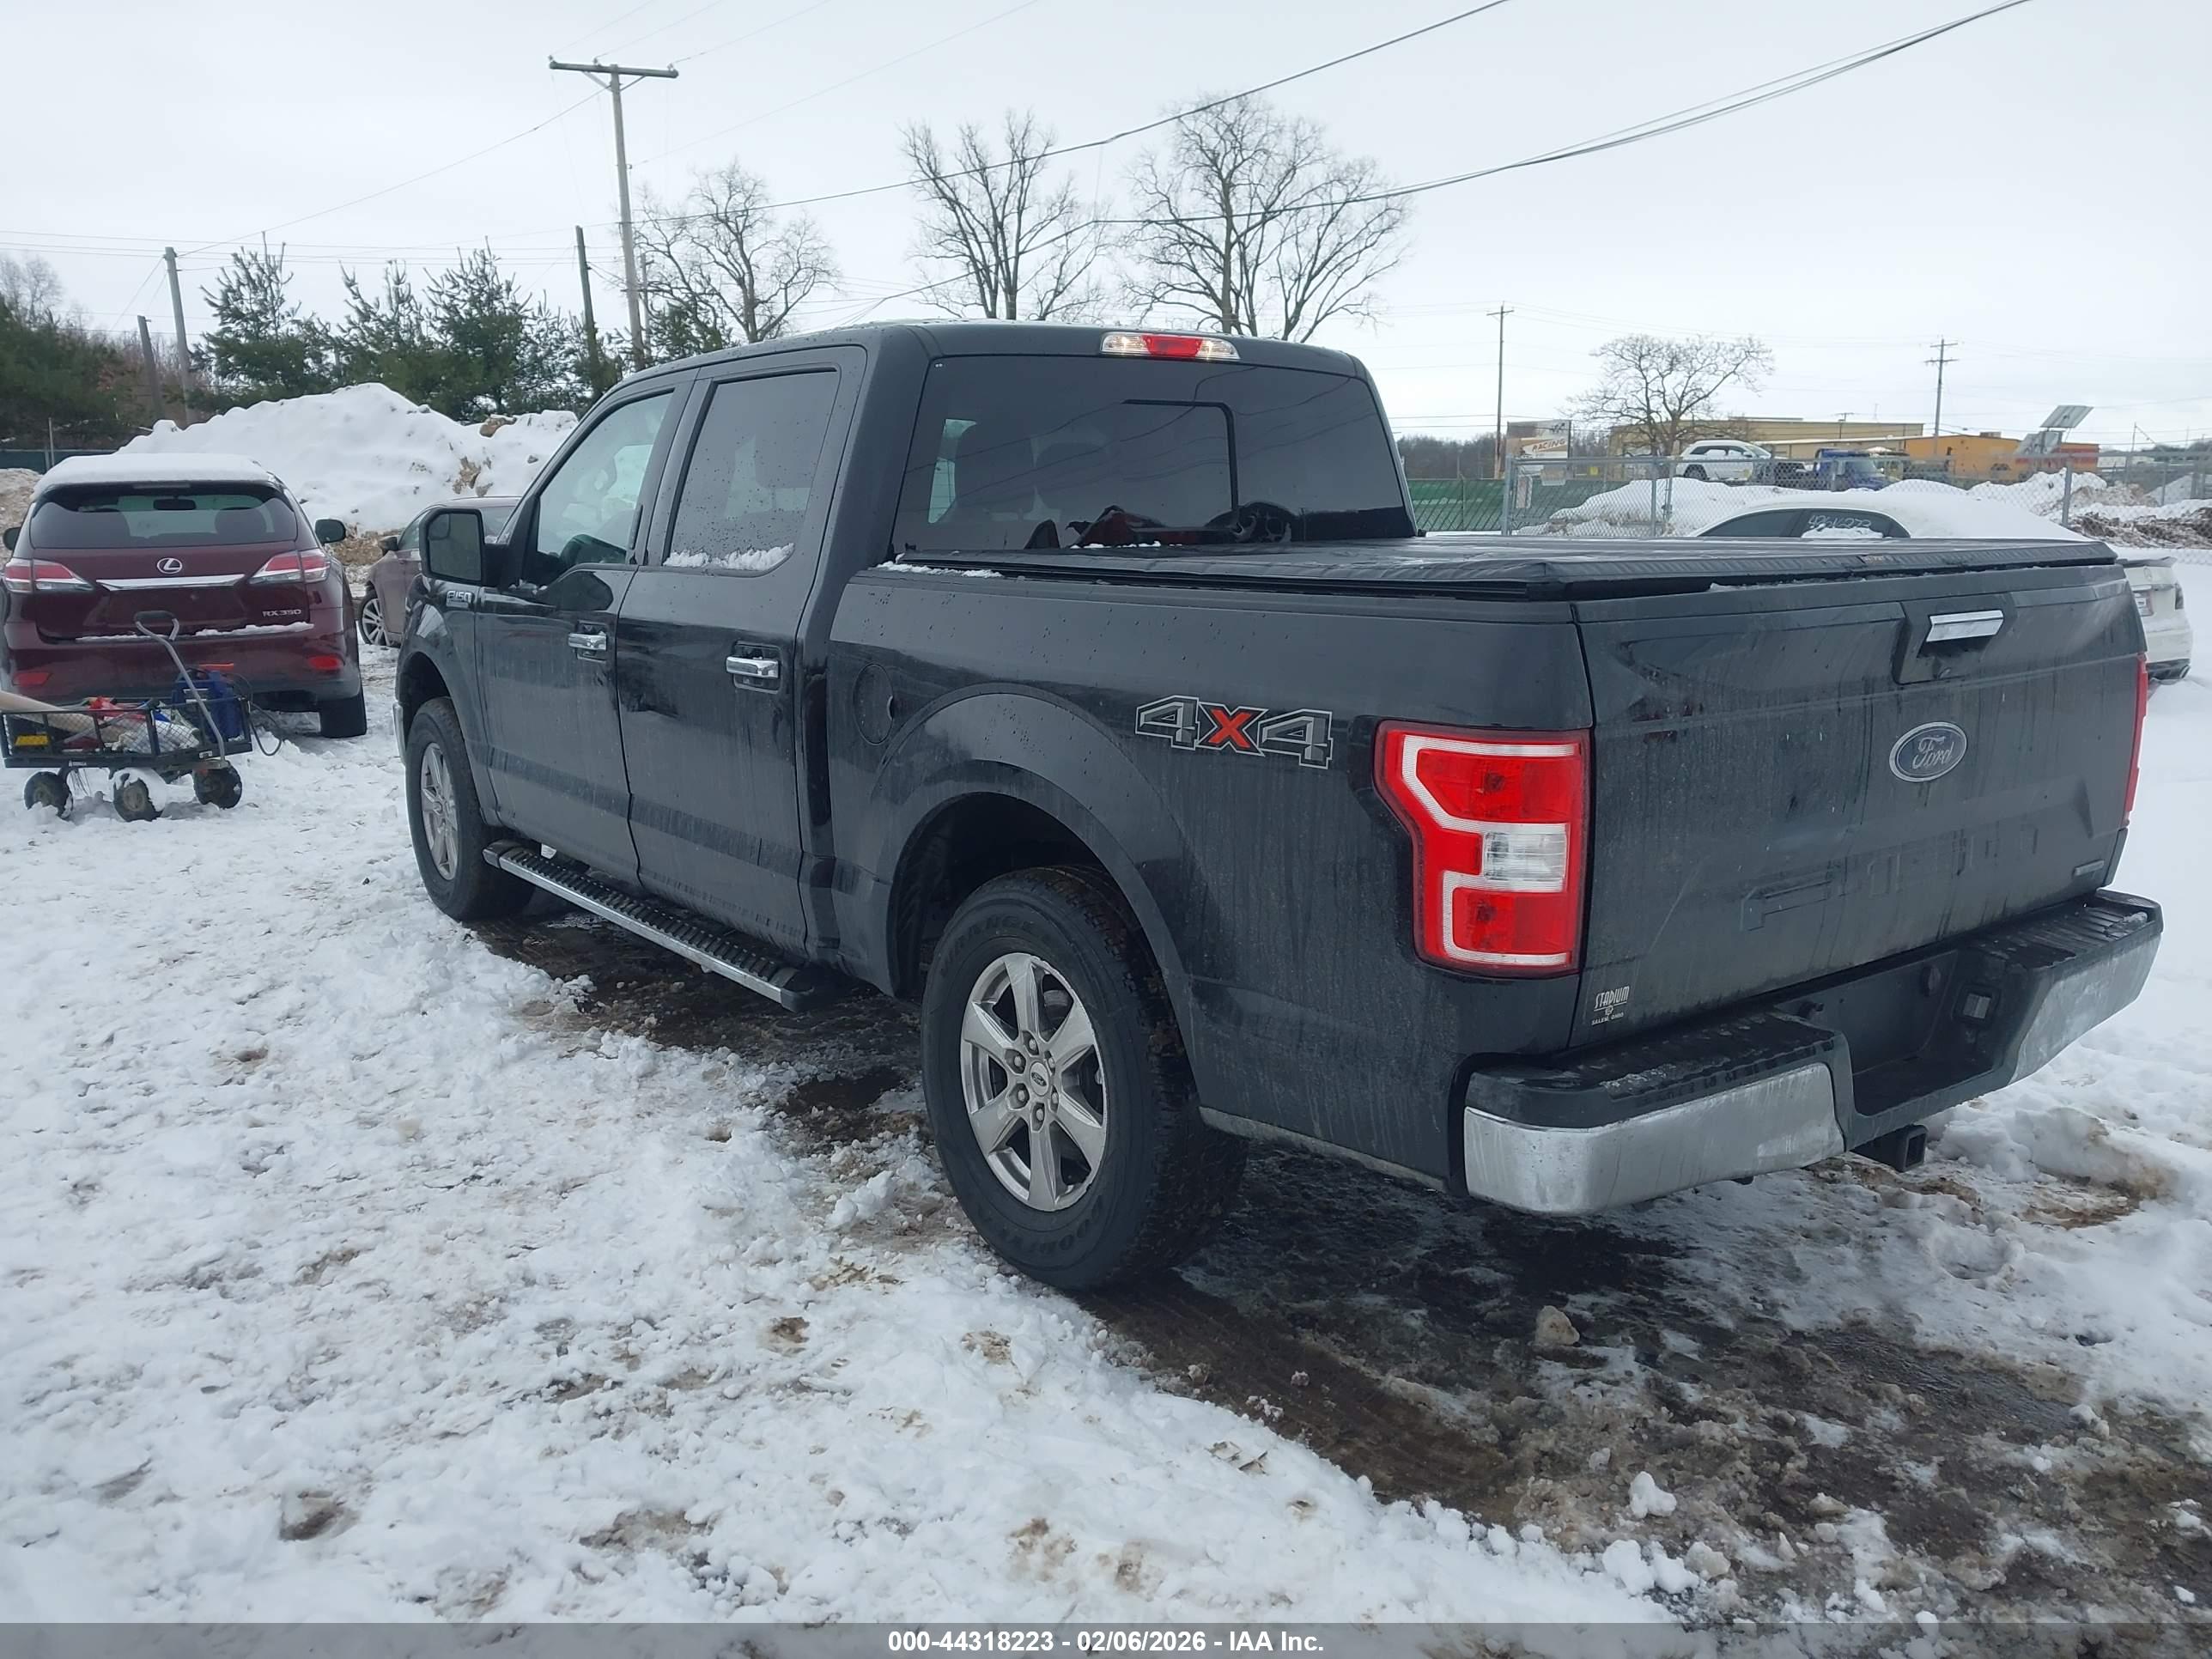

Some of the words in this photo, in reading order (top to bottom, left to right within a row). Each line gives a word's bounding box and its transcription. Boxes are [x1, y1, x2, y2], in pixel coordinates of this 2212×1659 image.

[1532, 438, 1566, 452] RACING
[1911, 735, 1955, 769] Ford
[1594, 986, 1630, 1009] STADIUM
